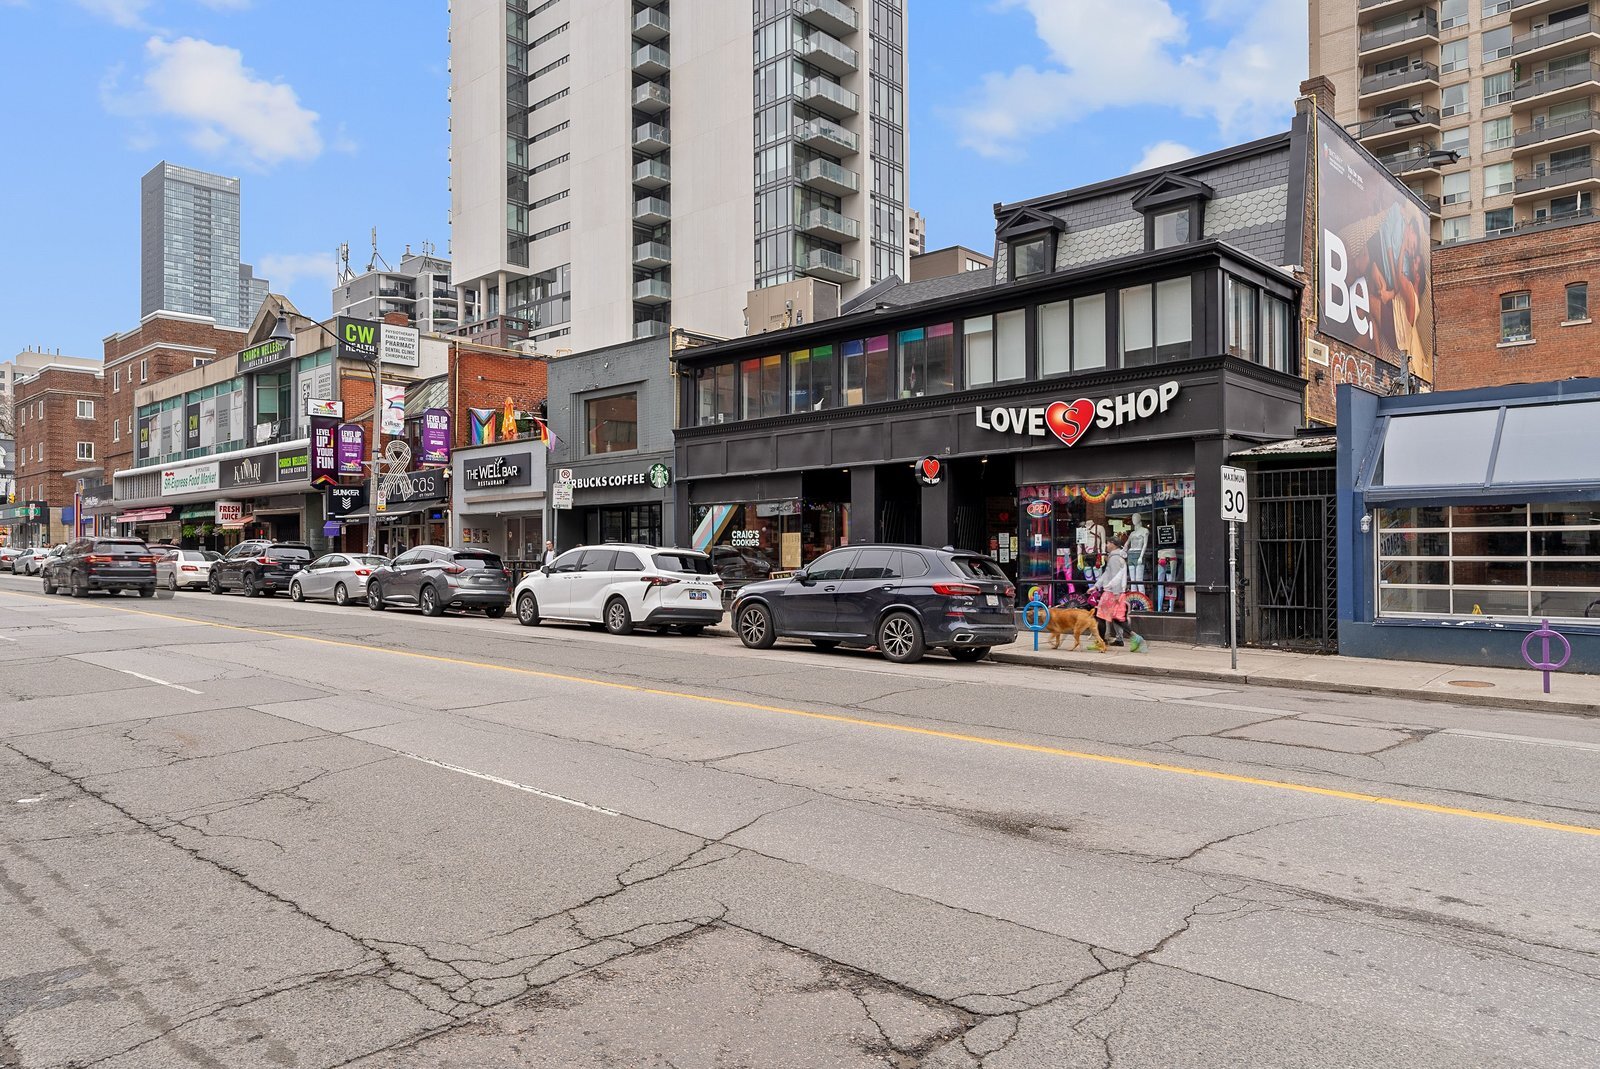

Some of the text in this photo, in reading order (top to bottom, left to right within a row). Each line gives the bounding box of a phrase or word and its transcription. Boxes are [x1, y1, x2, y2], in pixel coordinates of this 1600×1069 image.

[1324, 228, 1374, 340] Be.
[345, 323, 375, 344] CW
[385, 329, 415, 337] PHYSIOTHERAPY
[345, 342, 375, 354] HEALTH
[385, 340, 415, 350] PHARMACY
[975, 405, 1046, 436] LOVE
[1096, 380, 1180, 429] SHOP
[426, 414, 440, 423] LEVEL
[316, 428, 330, 436] LEVEL
[341, 430, 354, 438] LEVEL
[316, 436, 328, 447] UP
[316, 448, 334, 457] YOUR
[316, 456, 334, 469] FUN
[466, 462, 518, 480] THE WELL BAR
[189, 474, 200, 486] Food
[201, 472, 216, 484] Market
[572, 473, 645, 489] RBUCKS COFFEE
[1224, 472, 1244, 483] MAXIMUM
[1224, 490, 1244, 513] 30
[1028, 504, 1050, 514] OPEN
[732, 530, 760, 538] CRAIG'S
